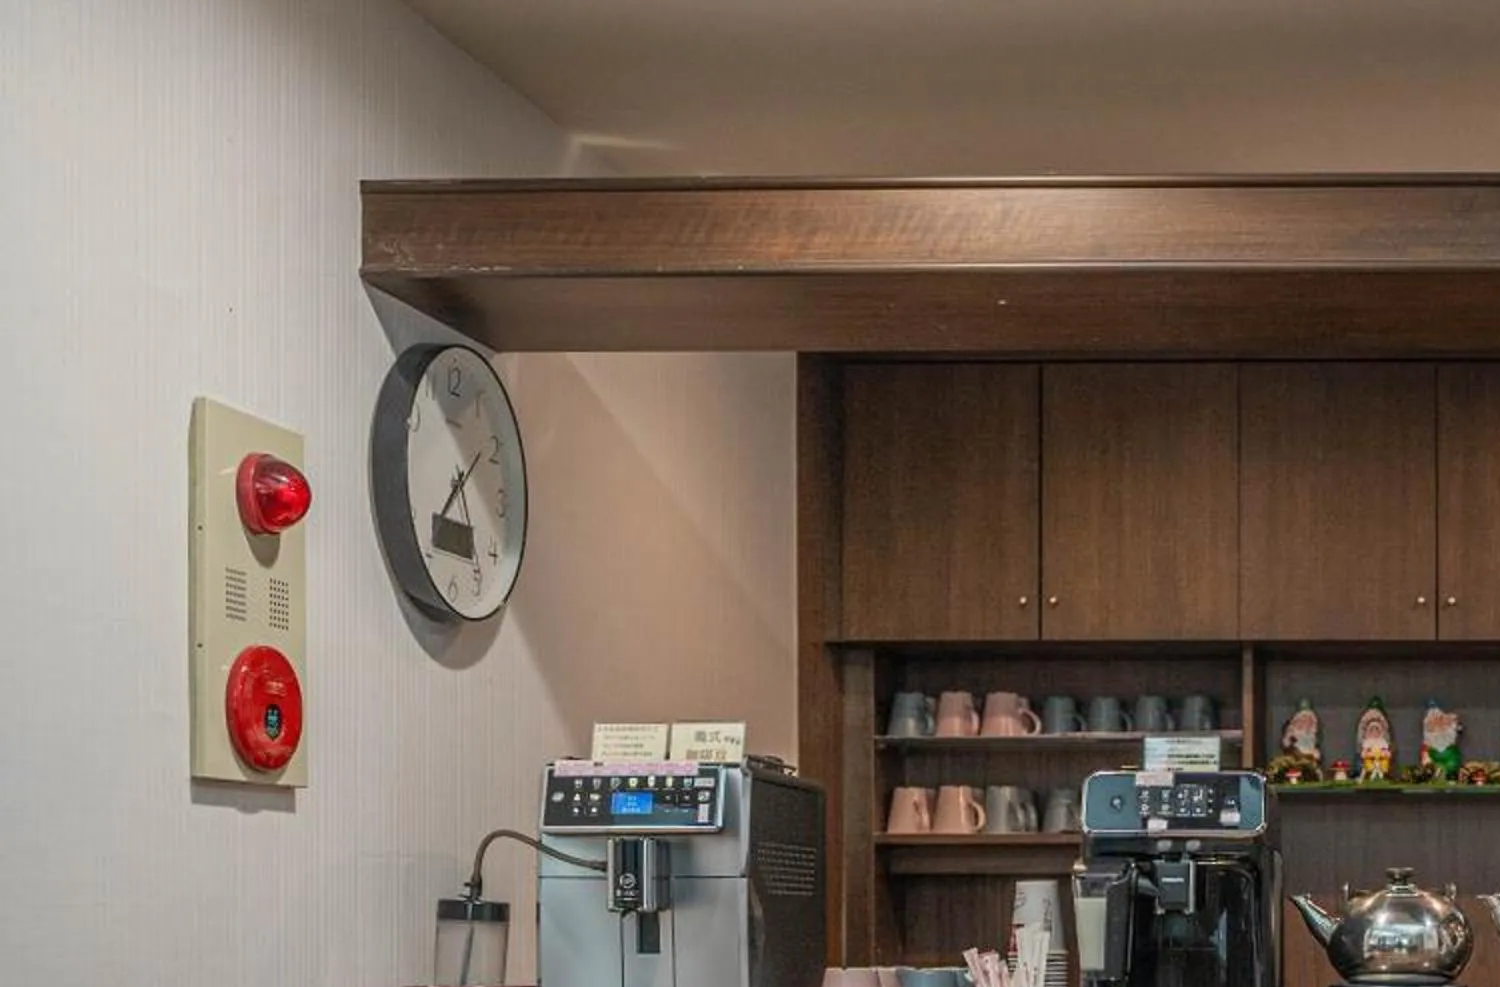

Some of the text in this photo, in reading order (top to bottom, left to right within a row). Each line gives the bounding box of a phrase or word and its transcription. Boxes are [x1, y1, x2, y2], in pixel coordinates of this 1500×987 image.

[488, 434, 504, 465] 2
[496, 487, 506, 519] 3
[488, 535, 499, 566] 4
